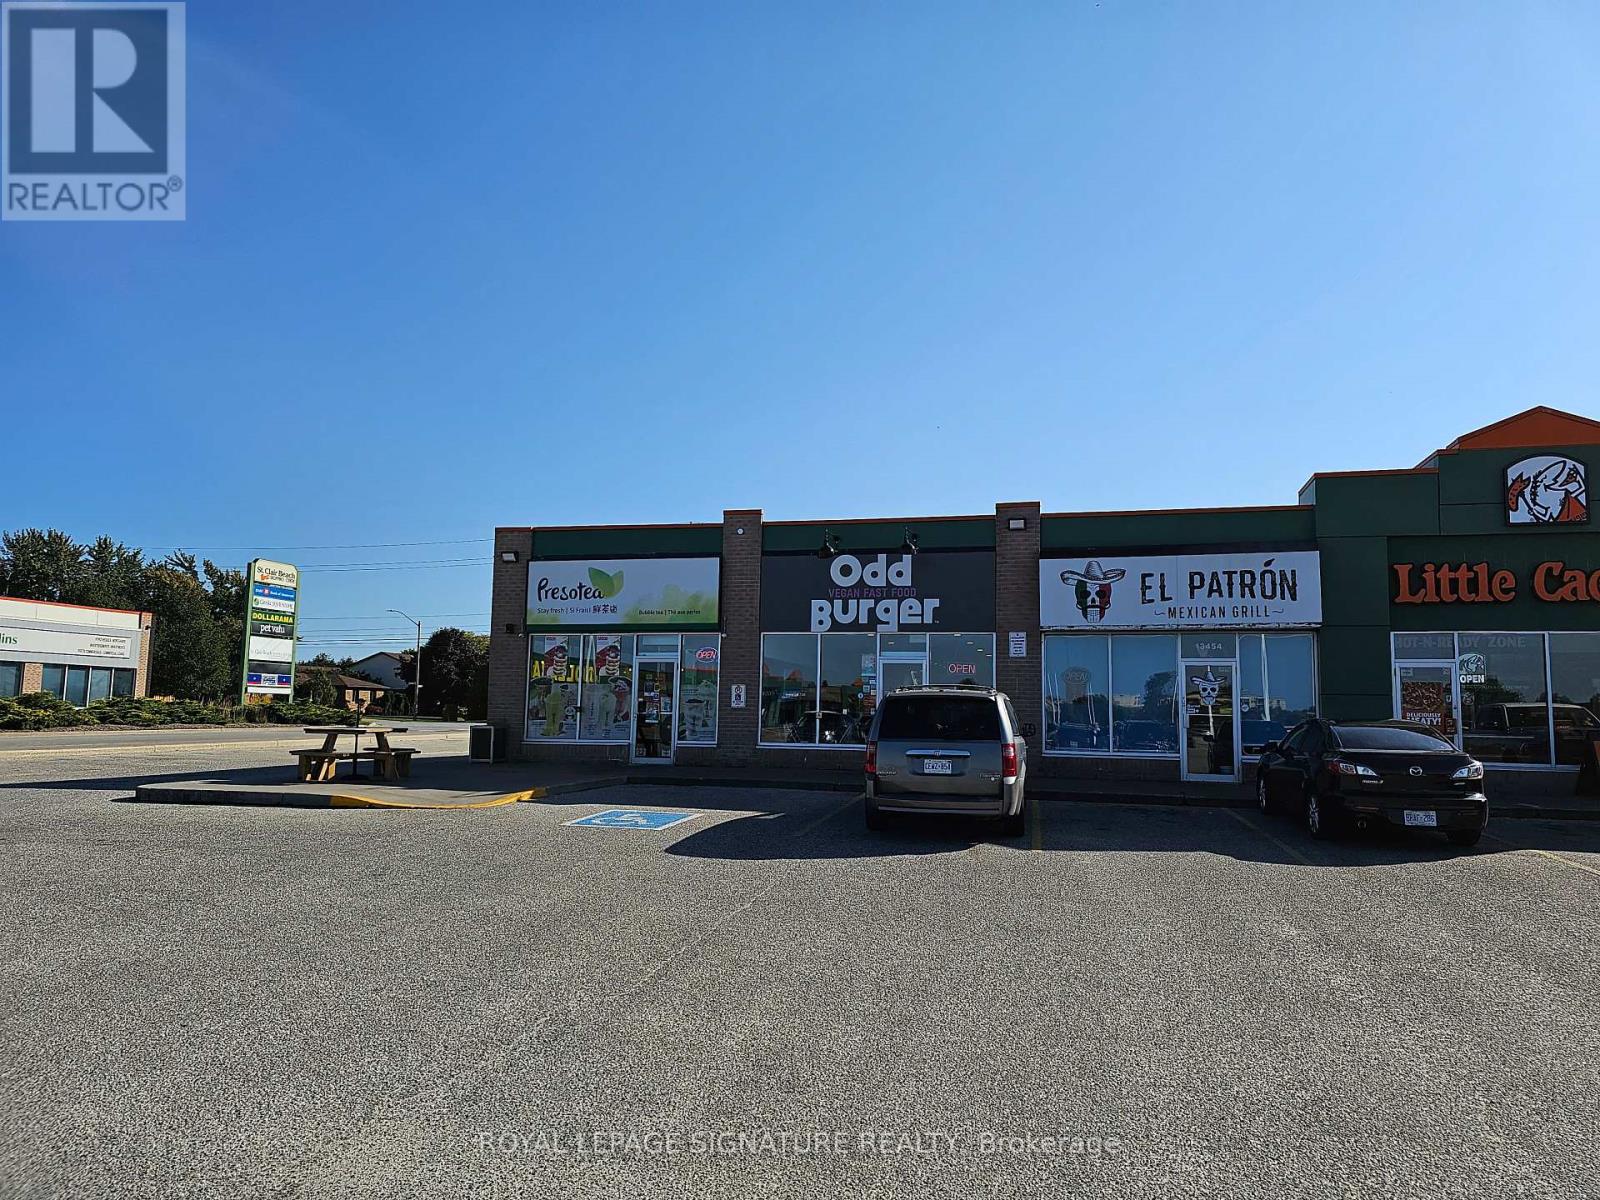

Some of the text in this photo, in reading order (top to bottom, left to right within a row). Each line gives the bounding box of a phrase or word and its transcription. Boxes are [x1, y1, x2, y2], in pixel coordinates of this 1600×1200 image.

[830, 553, 912, 587] Odd
[1140, 558, 1298, 604] EL PATRÓN
[1393, 562, 1516, 603] Little
[537, 577, 605, 602] Presotea
[829, 587, 917, 598] VEGAN FAST FOOD
[537, 607, 549, 615] Stay
[811, 598, 940, 632] Burger
[1168, 605, 1270, 619] MEXICAN GRILL
[252, 612, 294, 624] DOLLARAMA
[1196, 642, 1222, 650] 13454
[1487, 636, 1526, 648] ZONE
[697, 650, 716, 659] OPEN
[948, 663, 976, 674] OPEN
[1459, 674, 1485, 684] OPEN
